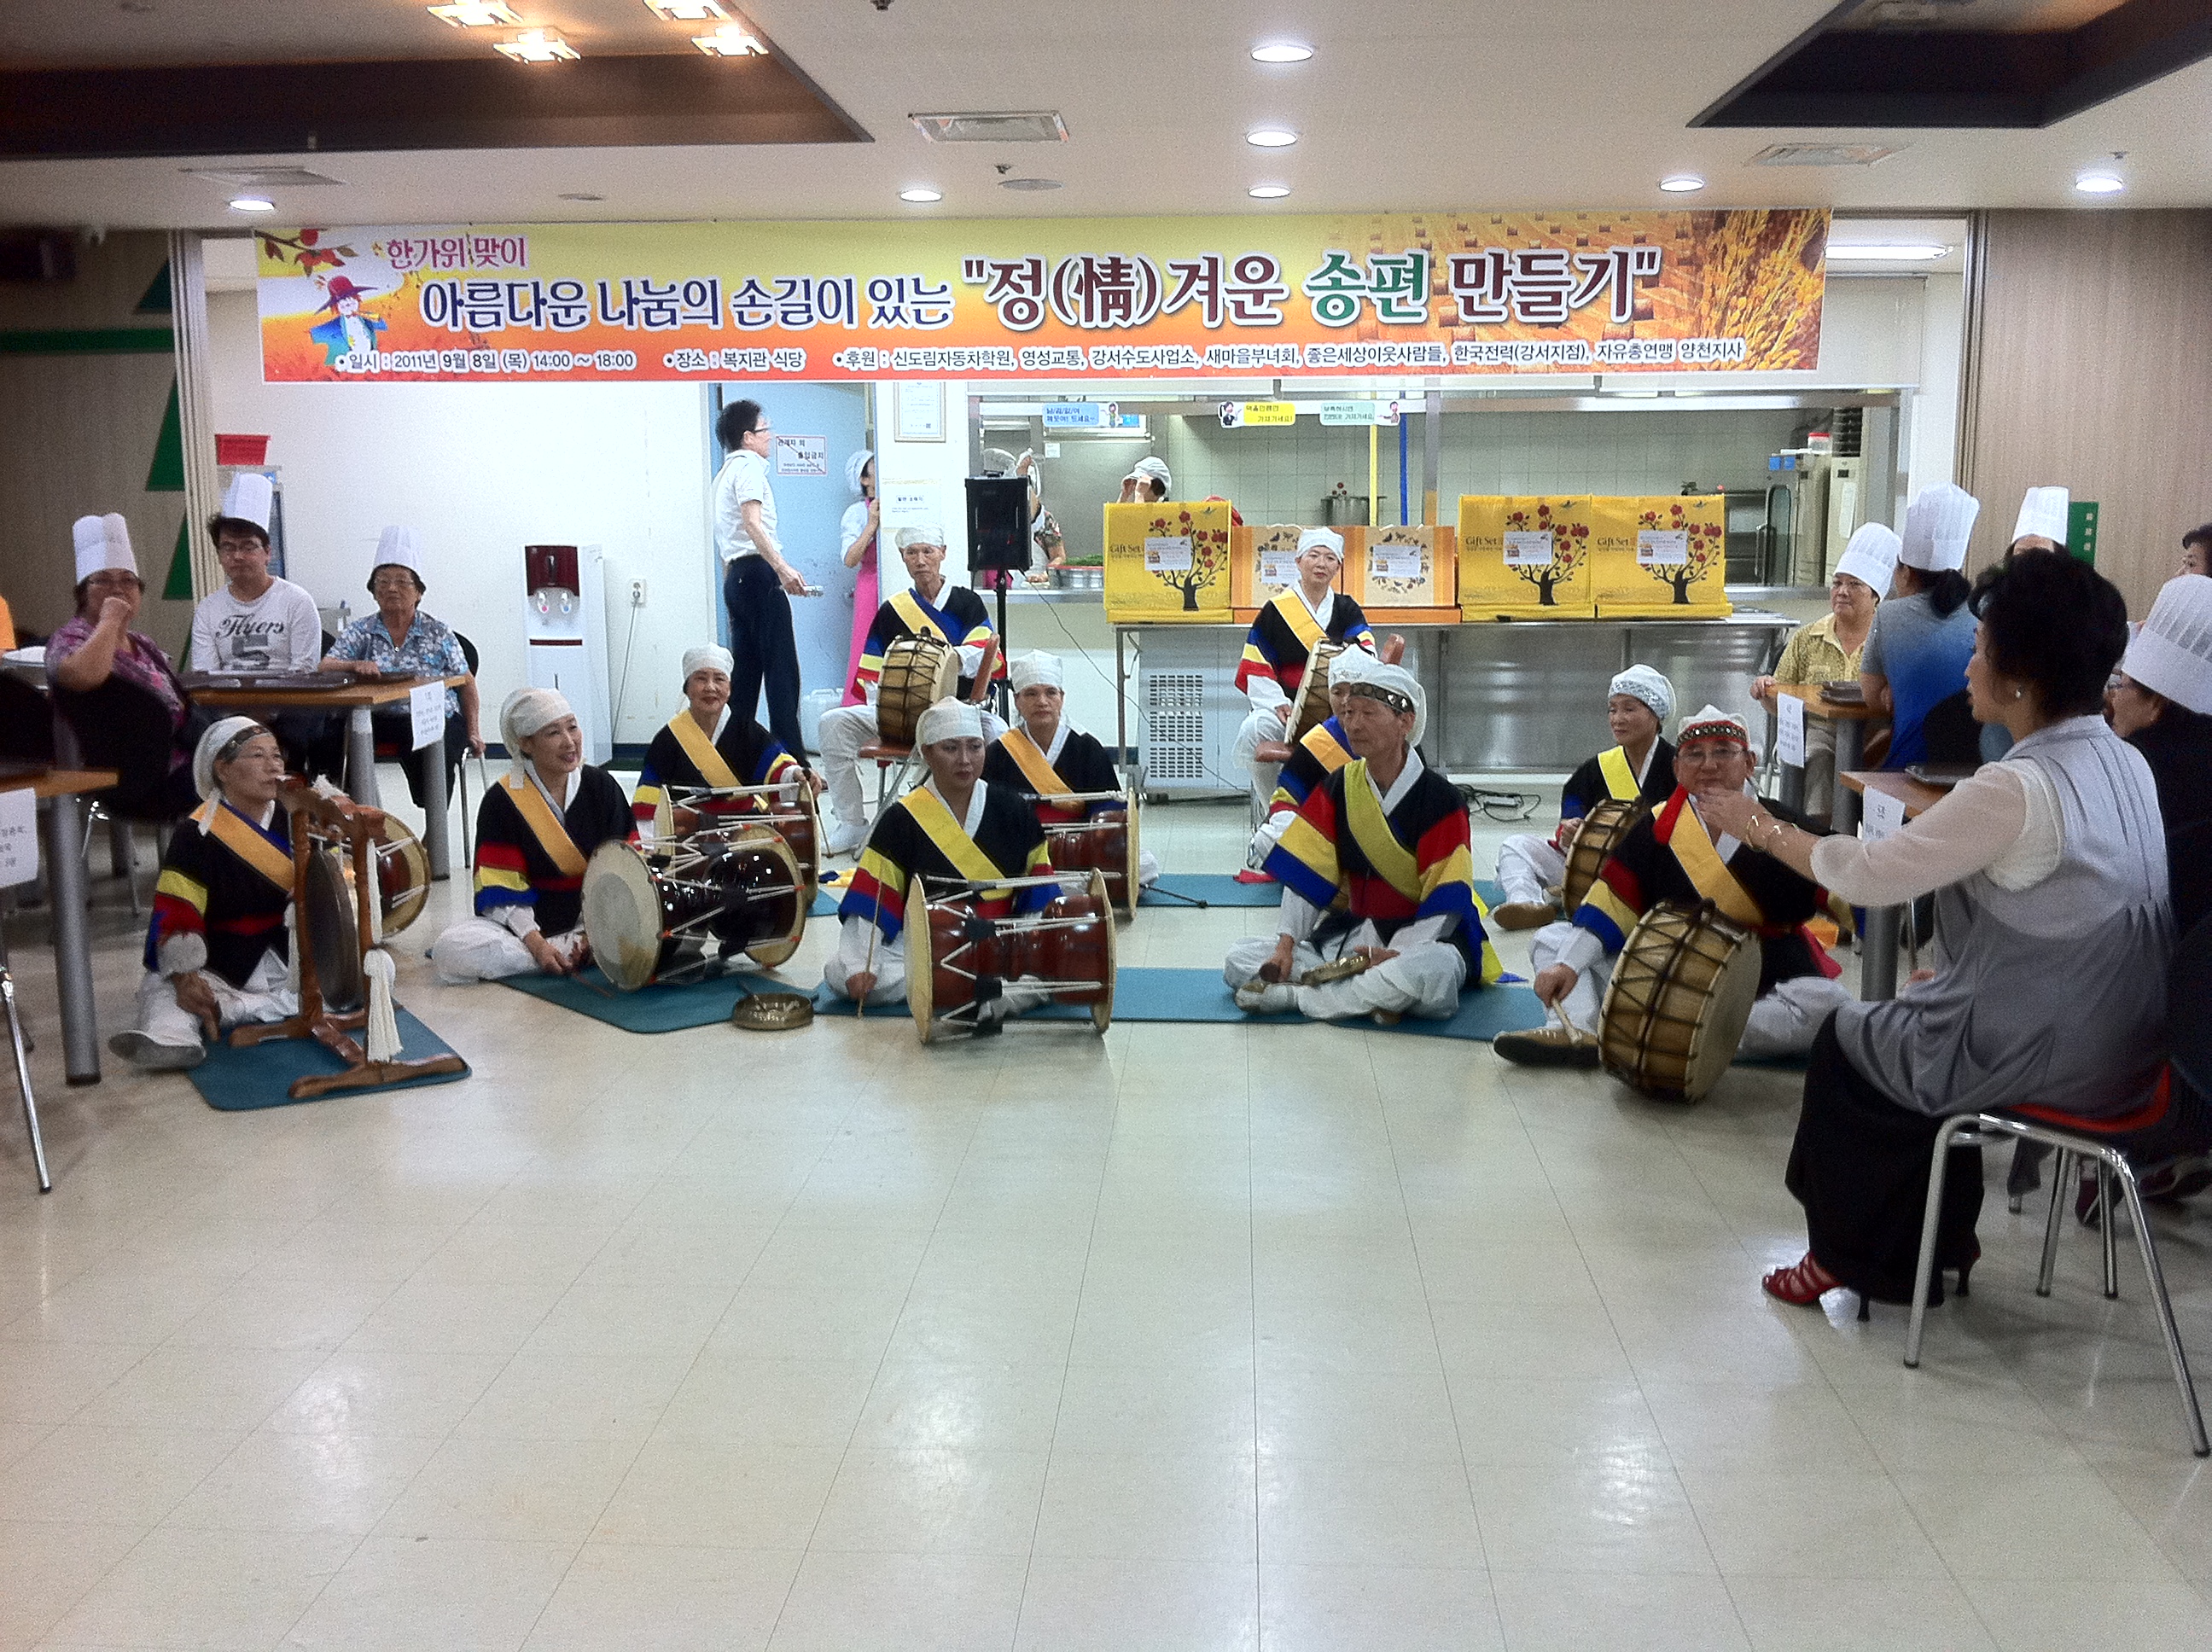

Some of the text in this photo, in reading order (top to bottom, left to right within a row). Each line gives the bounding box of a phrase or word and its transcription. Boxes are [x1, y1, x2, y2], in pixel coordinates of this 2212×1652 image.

[386, 236, 527, 269] 한가위 맞이
[424, 249, 1661, 329] 아름다운 나눔의 손길이 있는 "정(情)겨운 송편 만들기"
[348, 354, 376, 369] 일시
[394, 355, 436, 369] 2011년
[443, 354, 468, 369] 9월
[473, 353, 498, 369] 8일
[503, 352, 527, 369] (목)
[534, 353, 570, 368] 14:00
[599, 352, 633, 366] 18:00
[677, 352, 707, 367] 장소
[724, 351, 768, 367] 복지관
[774, 351, 804, 367] 식당
[847, 351, 876, 366] 후원
[894, 350, 1015, 368] 신도림자동차학원,
[1022, 349, 1085, 367] 영성교통,
[1091, 348, 1200, 365] 강서수도사업소,
[1207, 347, 1300, 364] 새마을부녀회,
[1454, 344, 1590, 362] 한국전력(강서지점),
[1598, 343, 1674, 360] 자유총연맹
[1681, 341, 1743, 359] 양천지사
[1110, 544, 1141, 554] Gift Set
[1465, 536, 1498, 547] Gift Set
[1597, 536, 1629, 546] Gift Set
[215, 613, 284, 638] Flyers
